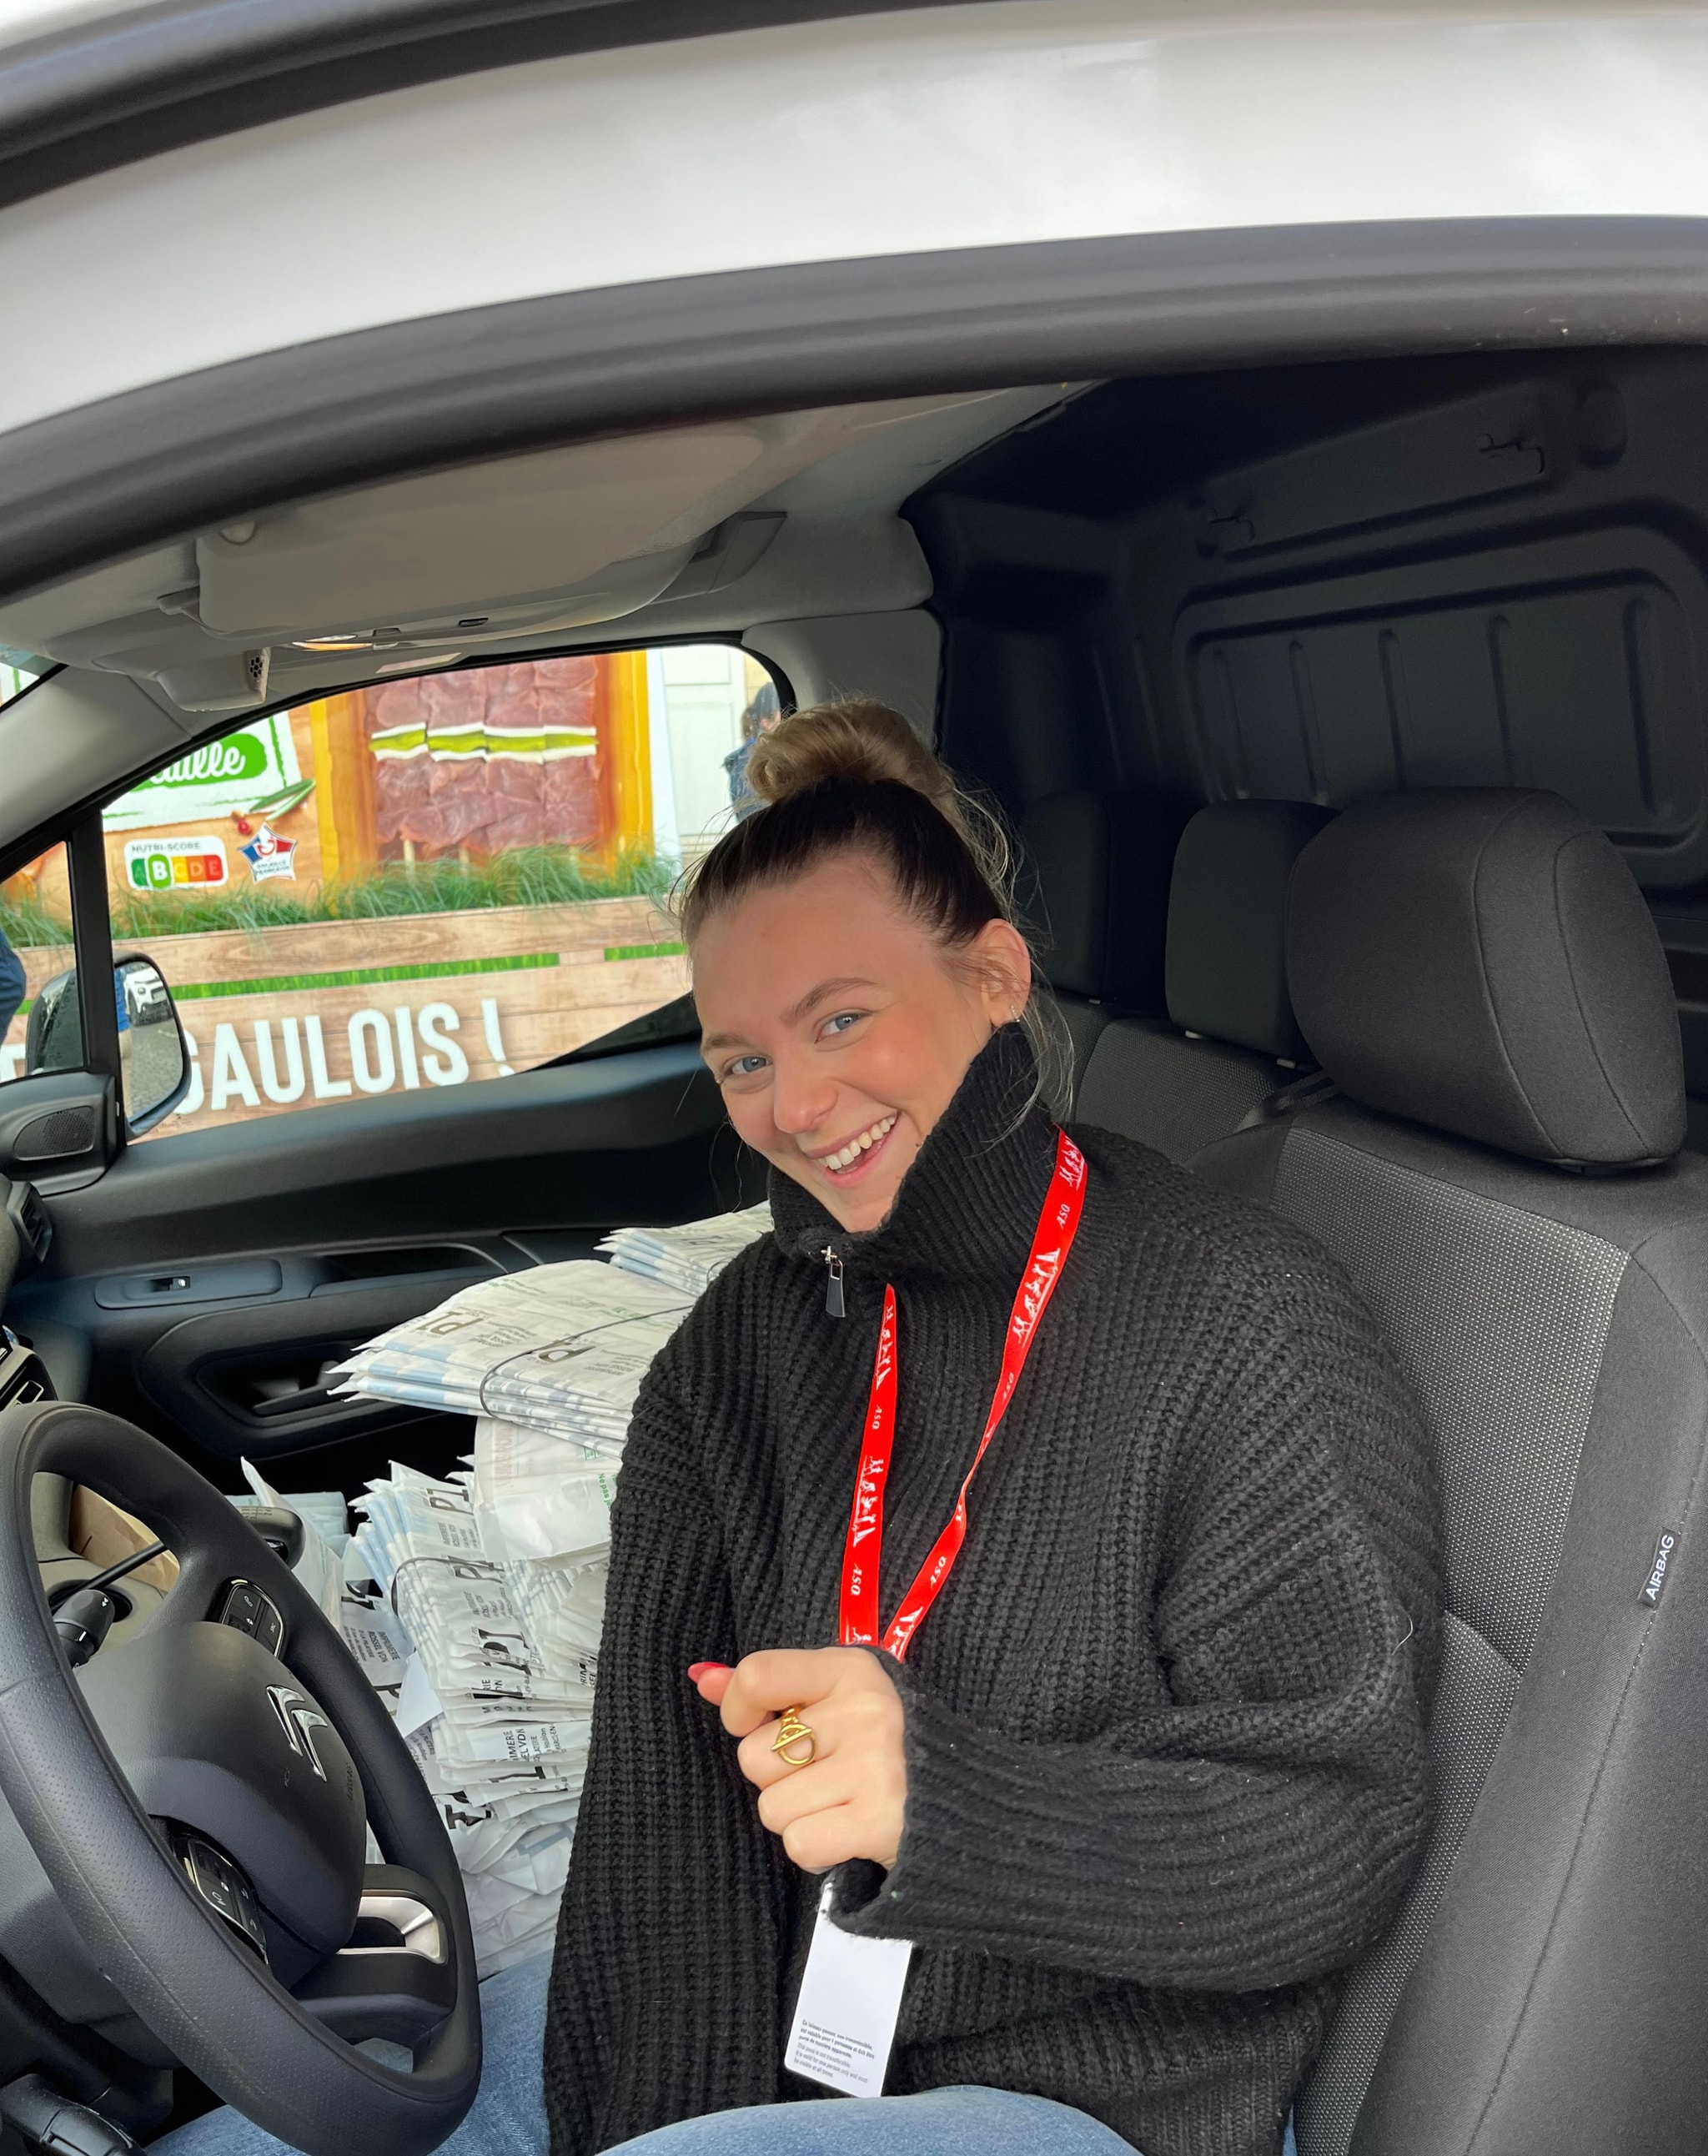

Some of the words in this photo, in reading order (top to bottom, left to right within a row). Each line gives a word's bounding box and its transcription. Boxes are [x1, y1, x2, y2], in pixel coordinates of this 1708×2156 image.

[132, 841, 200, 852] NUTRI-SCORE
[152, 860, 168, 881] B
[482, 999, 516, 1076] !
[426, 1488, 474, 1515] P1
[1645, 1535, 1674, 1601] AIRBAG
